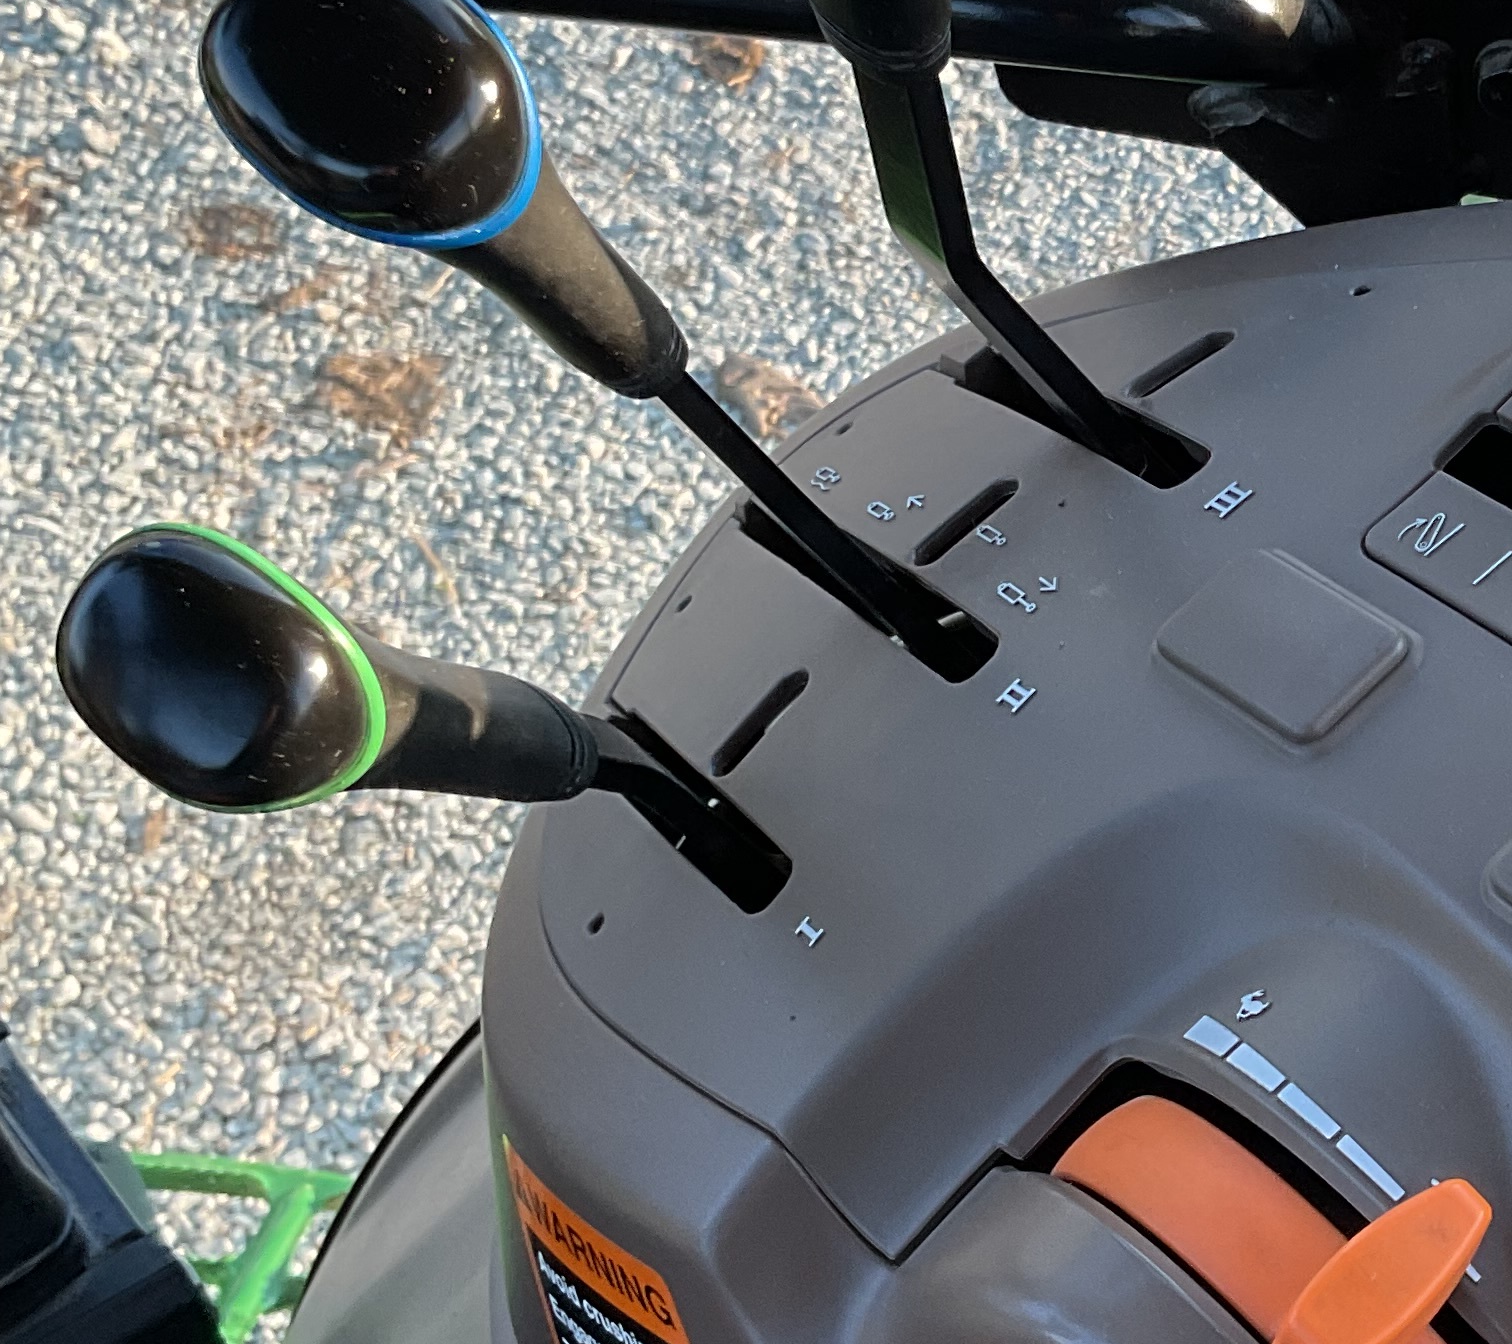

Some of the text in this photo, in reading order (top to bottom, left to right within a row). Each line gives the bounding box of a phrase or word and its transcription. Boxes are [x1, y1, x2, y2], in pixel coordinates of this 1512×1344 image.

[1203, 480, 1253, 519] III
[995, 678, 1037, 714] II
[523, 1182, 677, 1331] WARNING
[538, 1250, 581, 1308] Avoid
